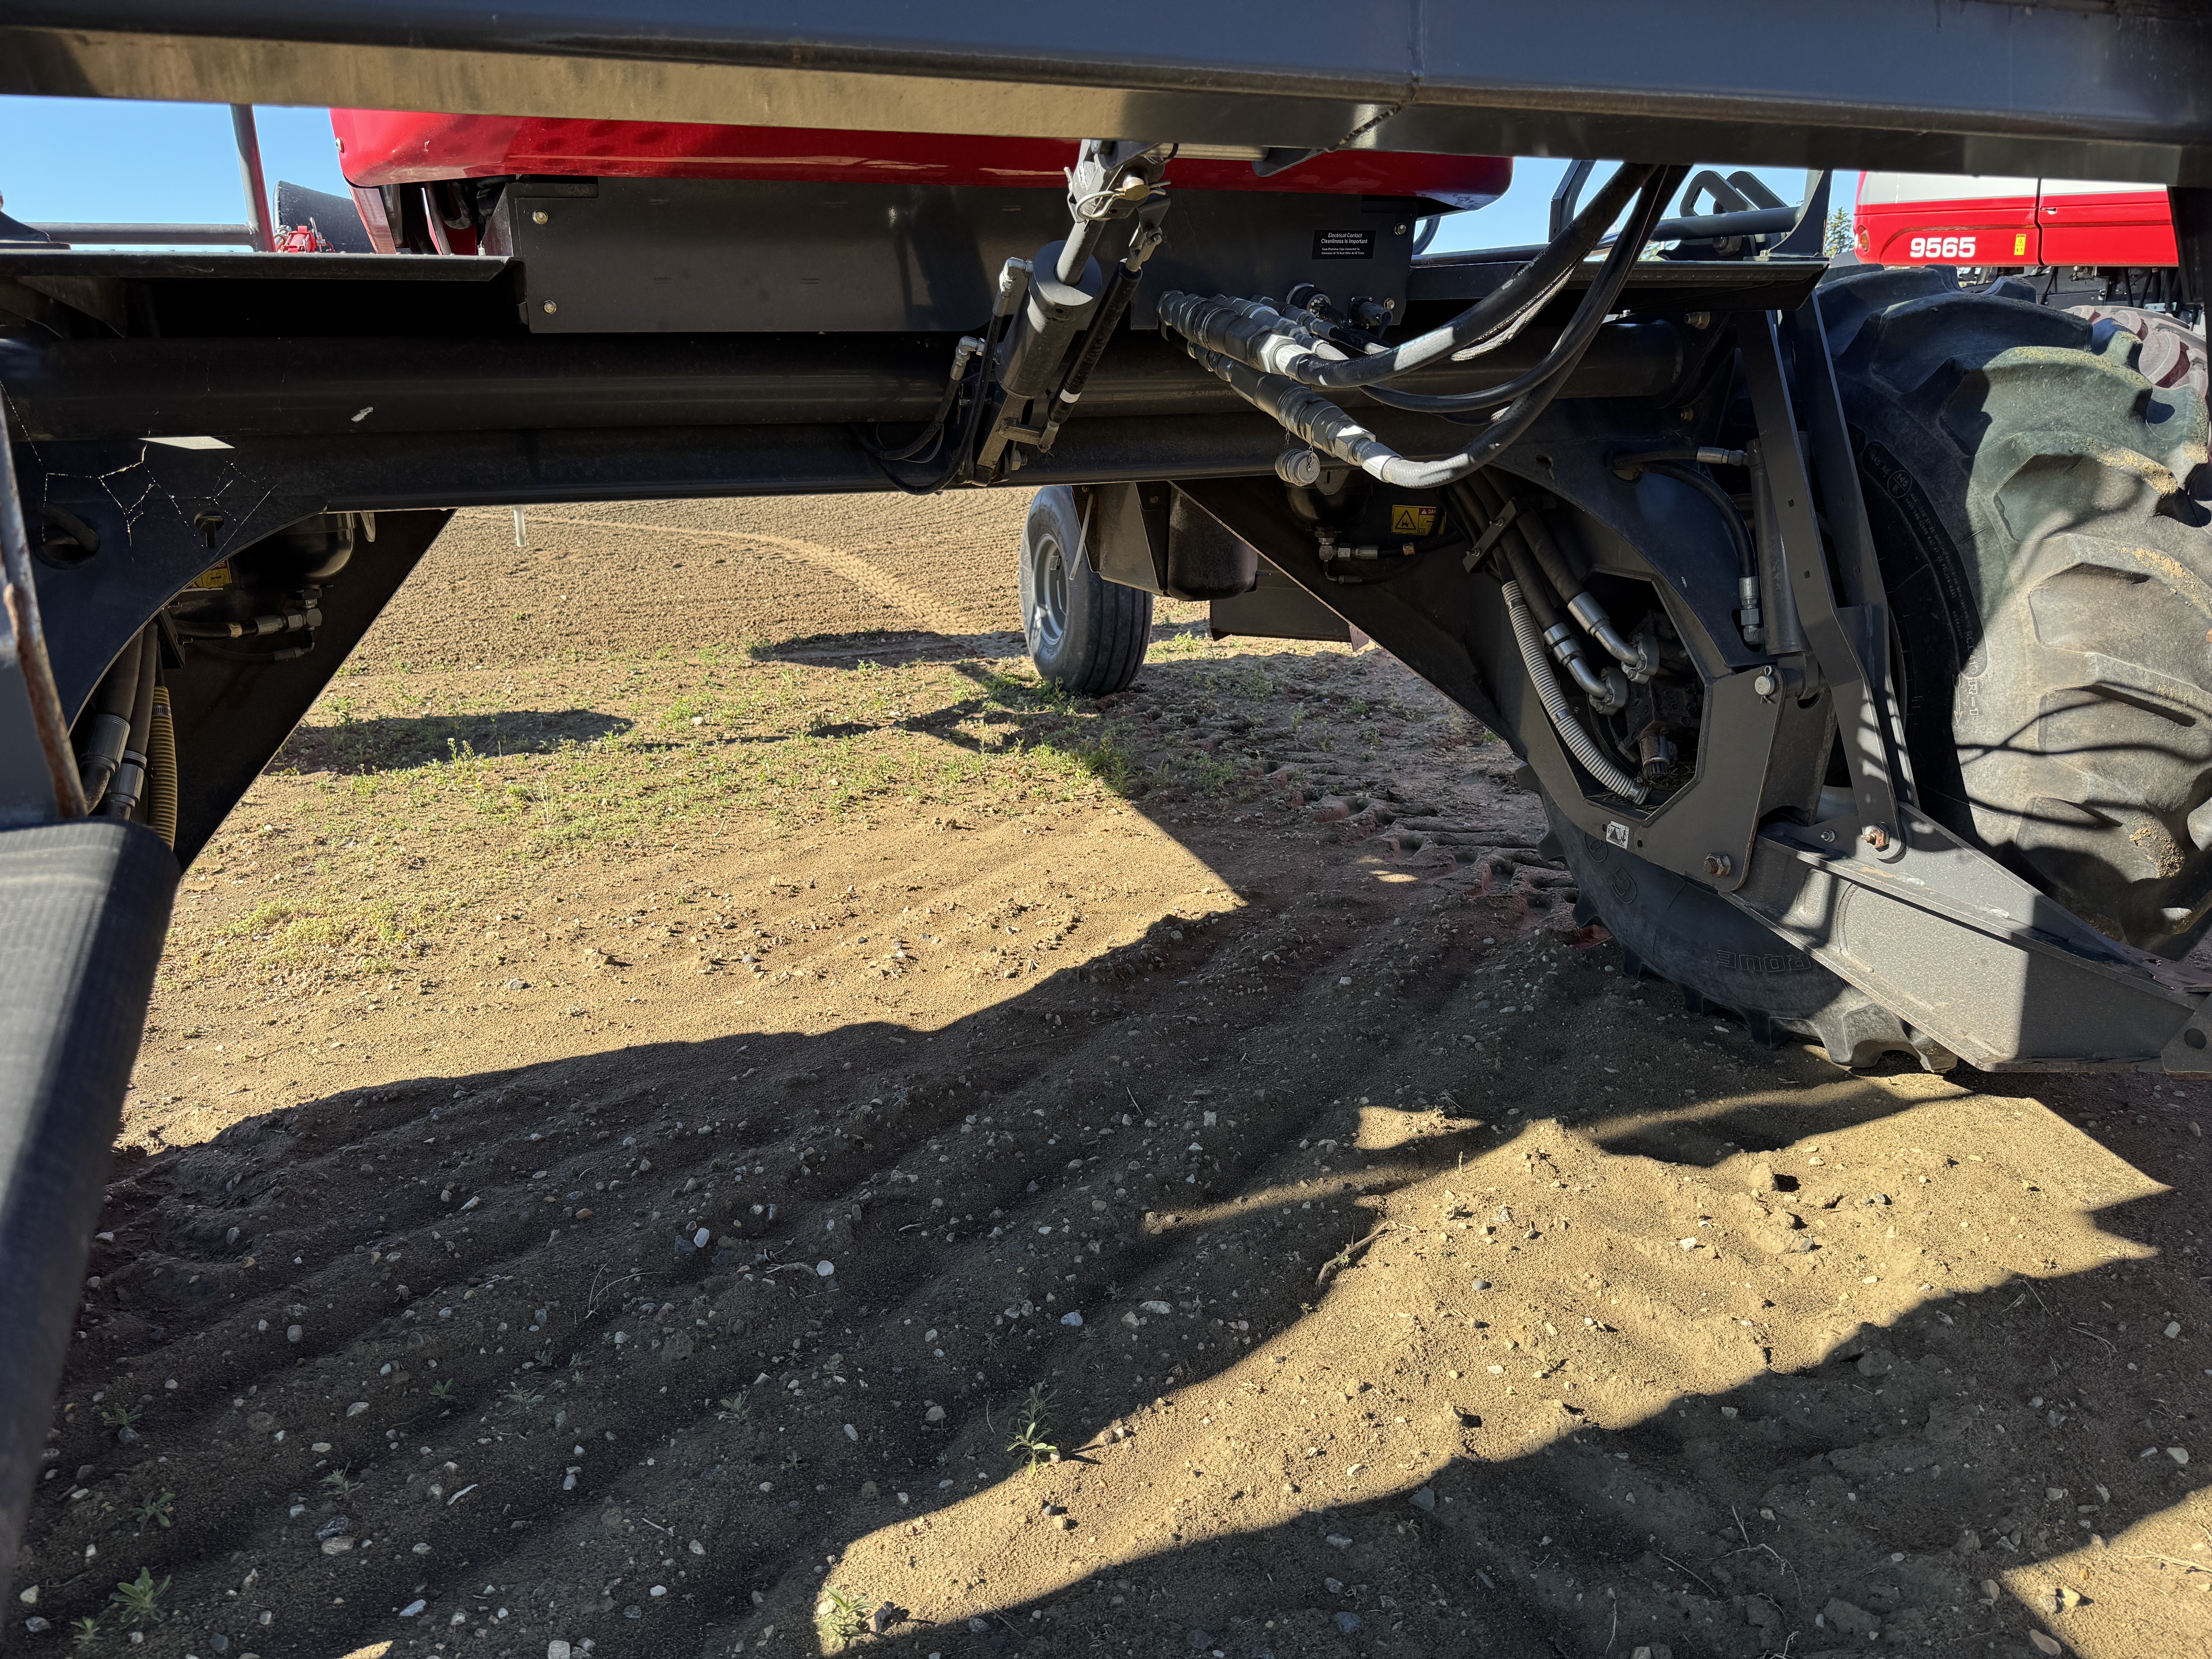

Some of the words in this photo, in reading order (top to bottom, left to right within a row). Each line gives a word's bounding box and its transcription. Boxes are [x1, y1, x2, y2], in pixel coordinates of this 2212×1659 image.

[1910, 237, 1976, 258] 9565
[1897, 473, 1909, 487] 145
[1717, 950, 1816, 972] RQUE
